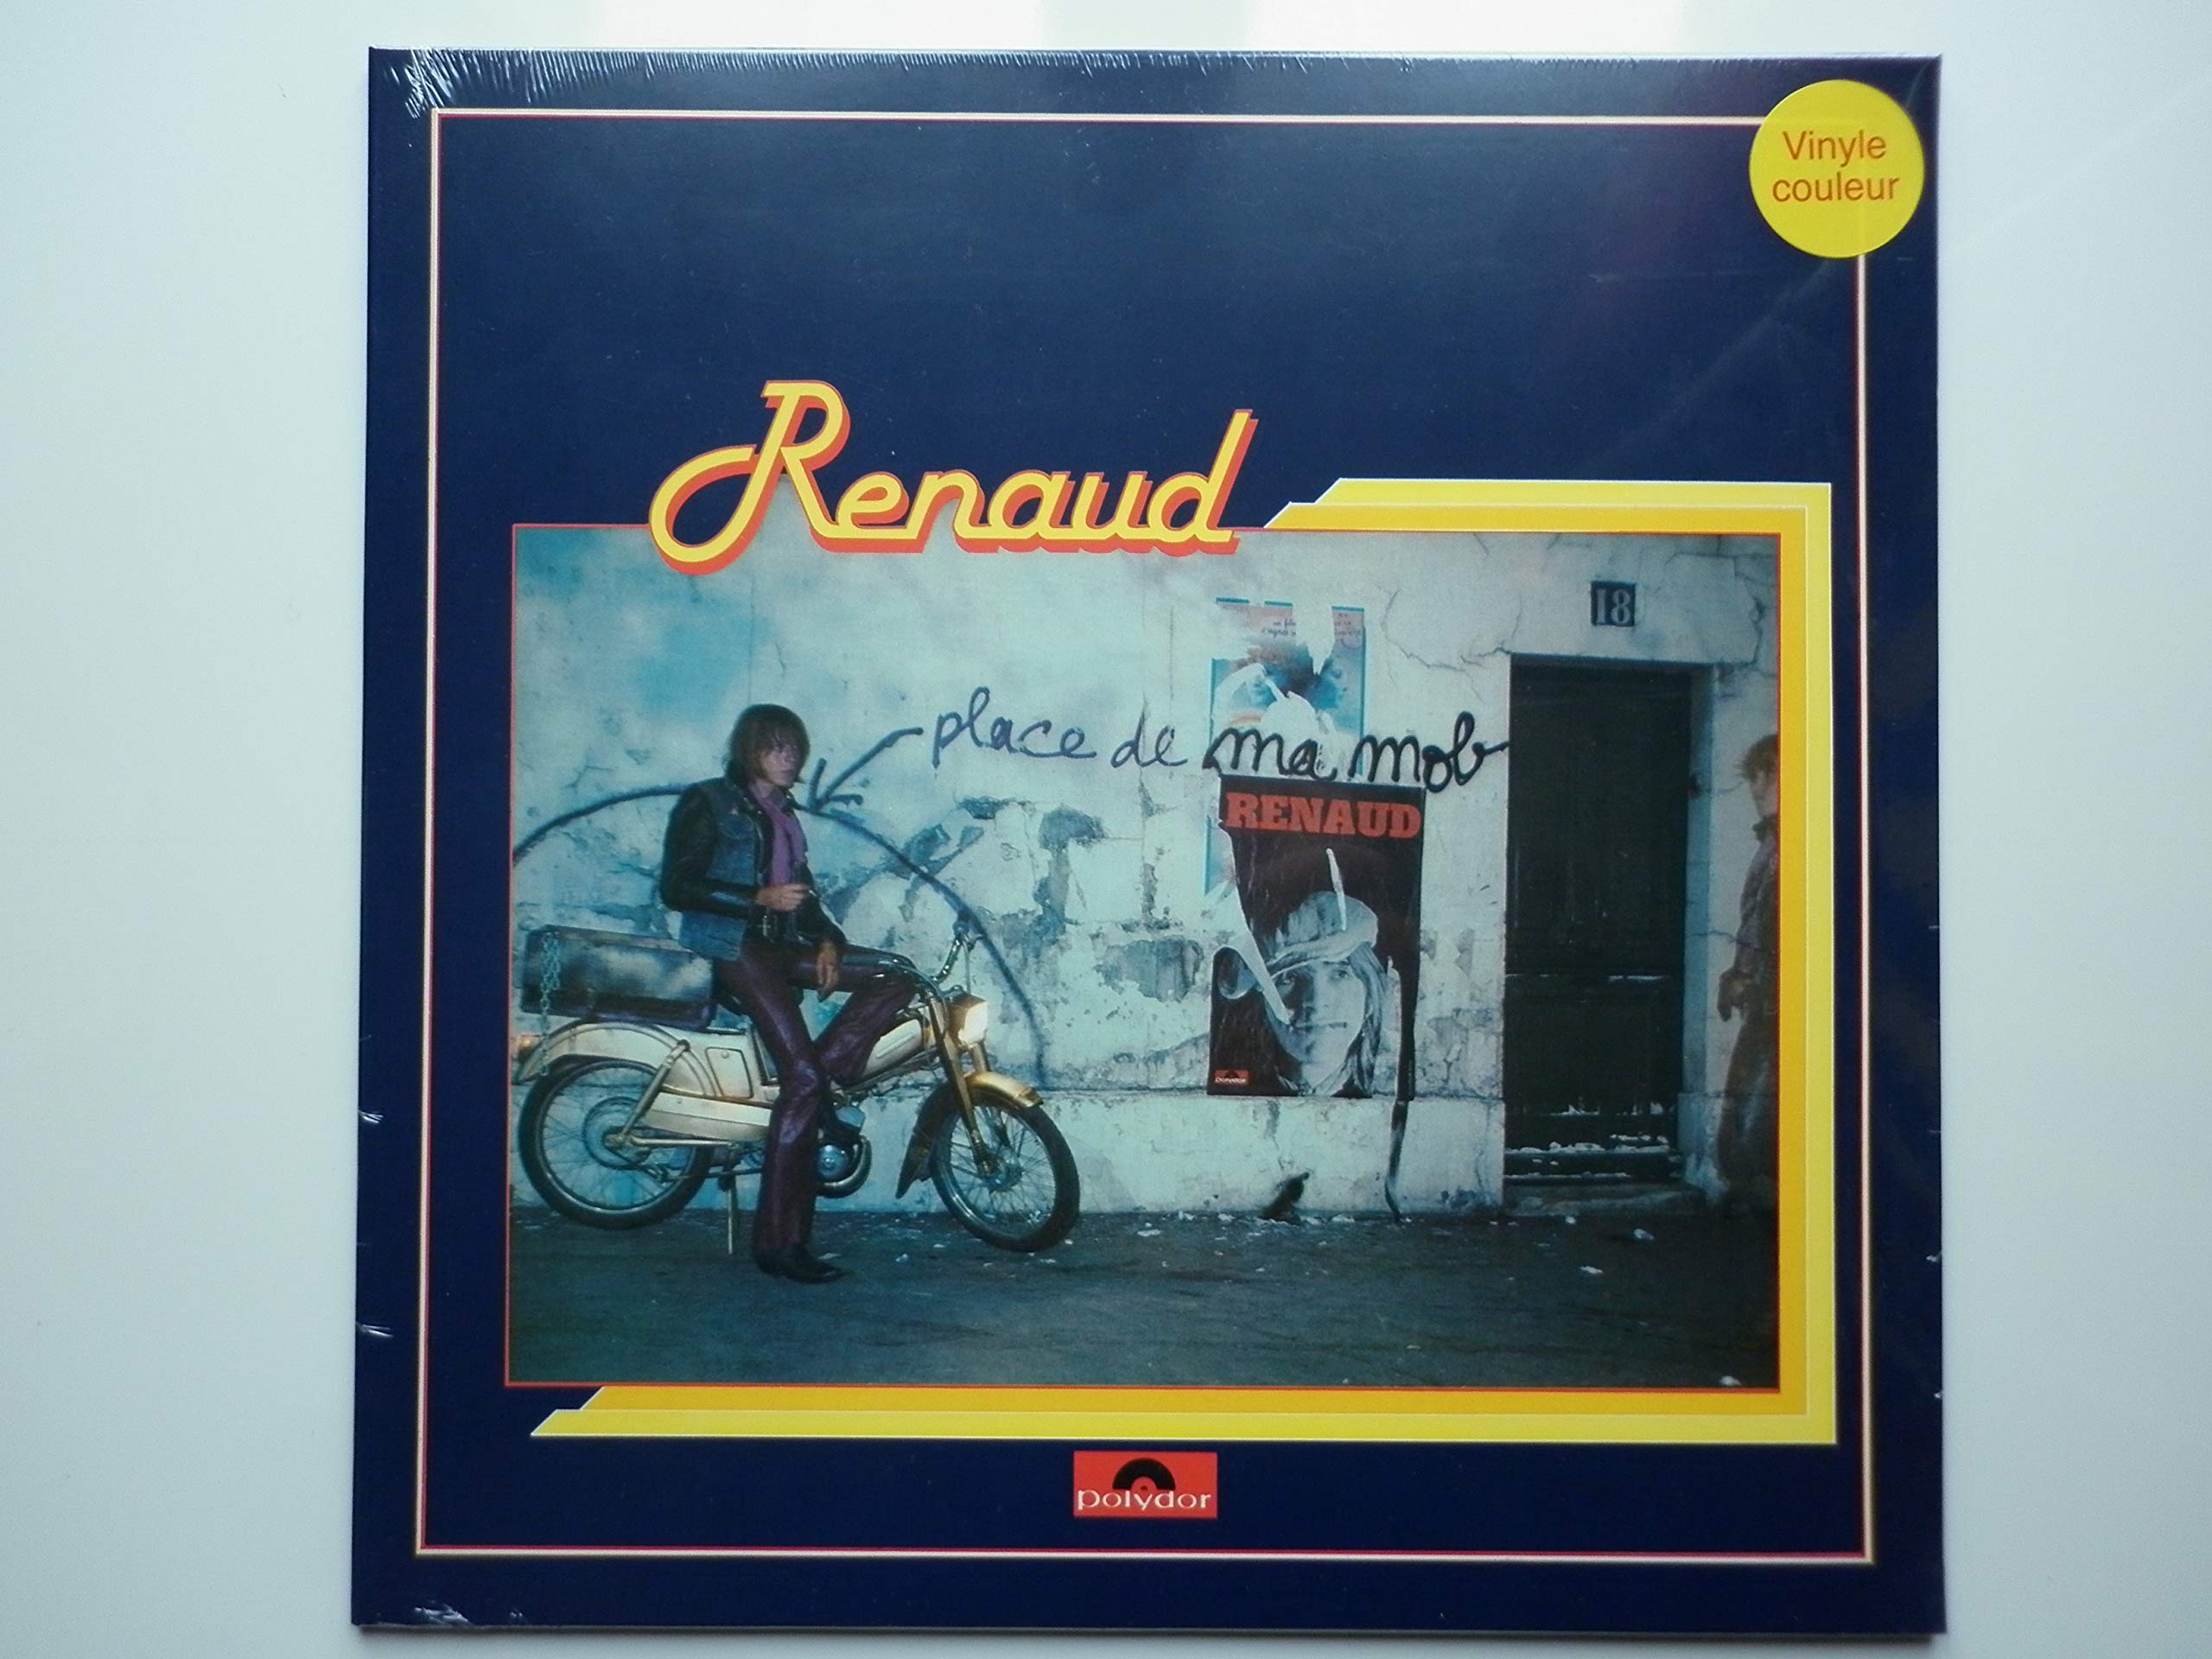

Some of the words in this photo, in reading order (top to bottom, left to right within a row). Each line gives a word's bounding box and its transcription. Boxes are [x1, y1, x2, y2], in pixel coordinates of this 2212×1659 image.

[1782, 129, 1887, 168] Vinyle
[1772, 171, 1900, 202] couleur
[648, 379, 1259, 575] Renaud
[1596, 588, 1631, 624] 18
[931, 687, 1097, 769] place
[1110, 692, 1188, 768] de
[1202, 727, 1338, 781] ma
[1347, 711, 1510, 793] mob
[1225, 791, 1422, 839] RENAUD
[1077, 1489, 1211, 1510] polydor
